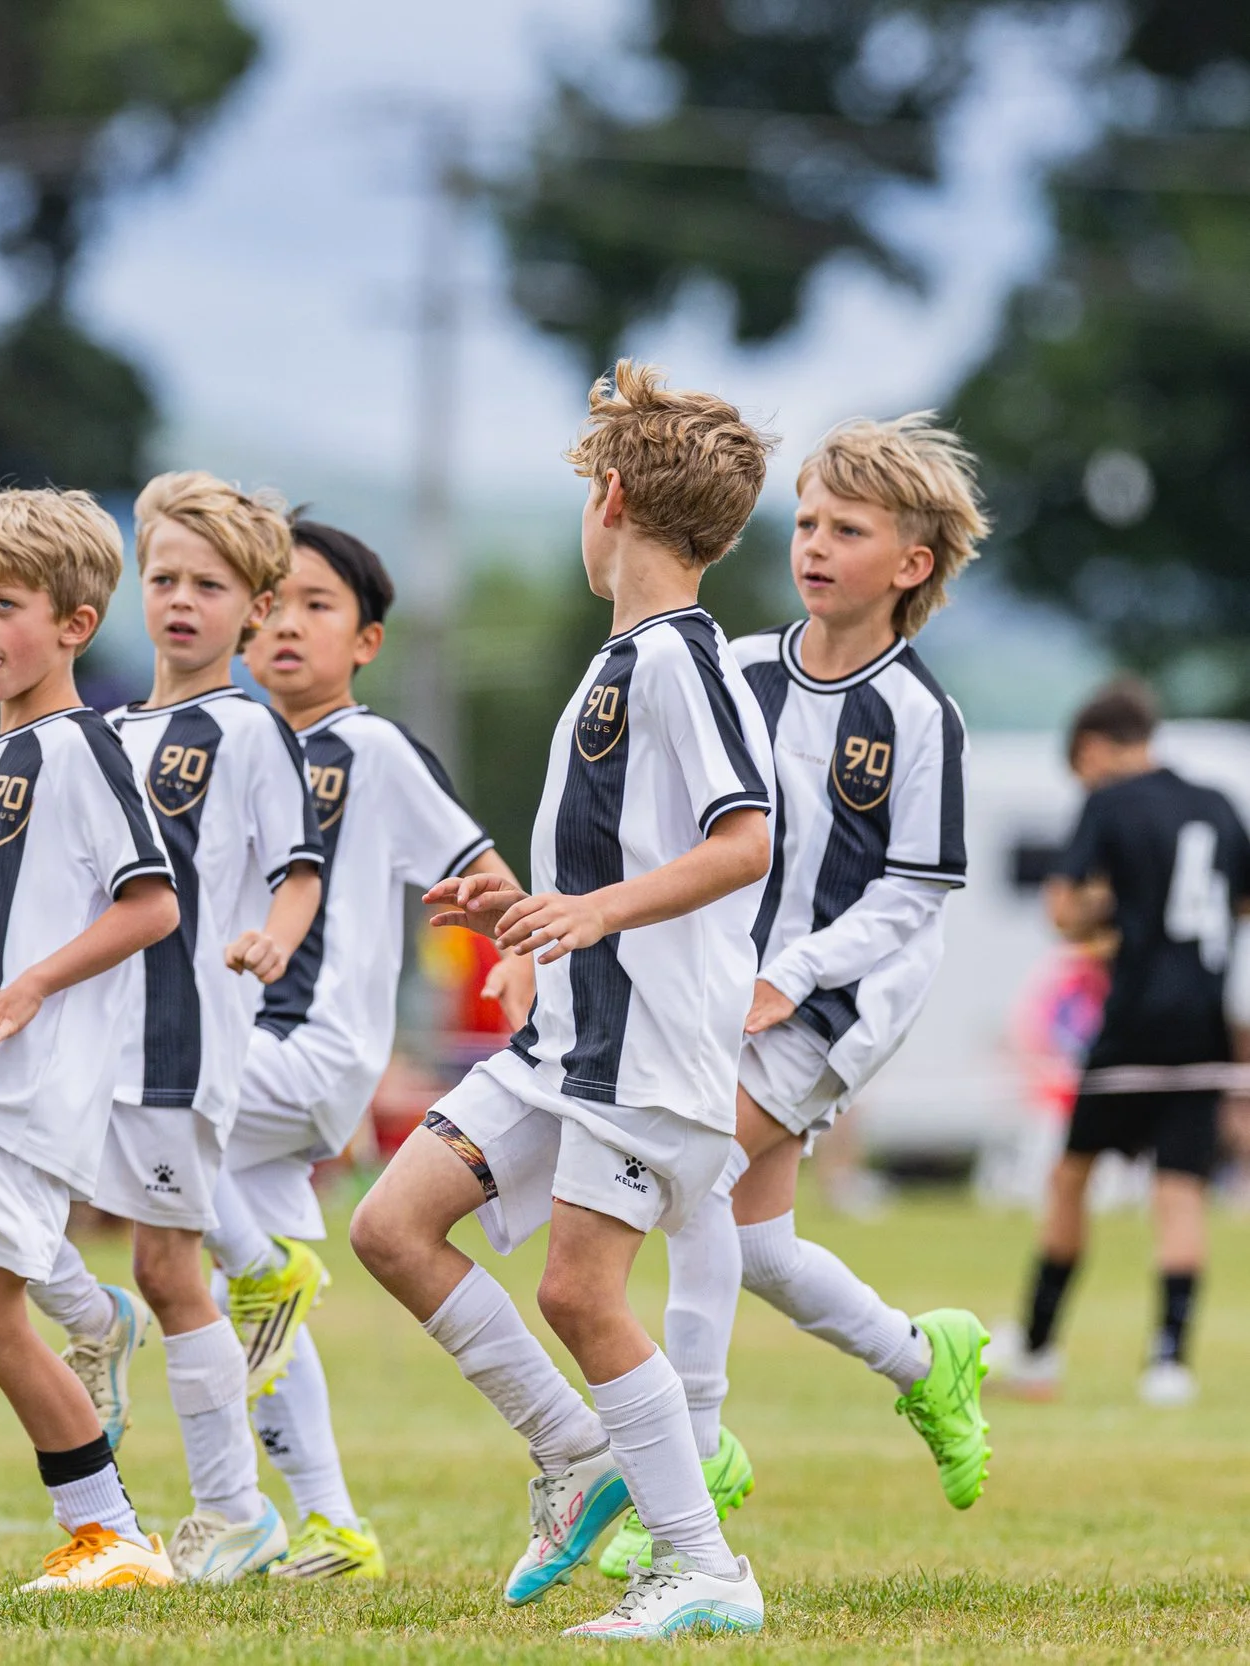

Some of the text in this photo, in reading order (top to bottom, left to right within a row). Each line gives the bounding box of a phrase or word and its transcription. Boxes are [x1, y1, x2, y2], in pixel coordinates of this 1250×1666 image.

[584, 685, 619, 721] 90
[581, 721, 610, 733] PLUS
[159, 745, 208, 783] 90
[845, 736, 891, 777] 90
[843, 772, 880, 788] PLUS
[1163, 820, 1230, 974] 4
[615, 1173, 648, 1193] KELME
